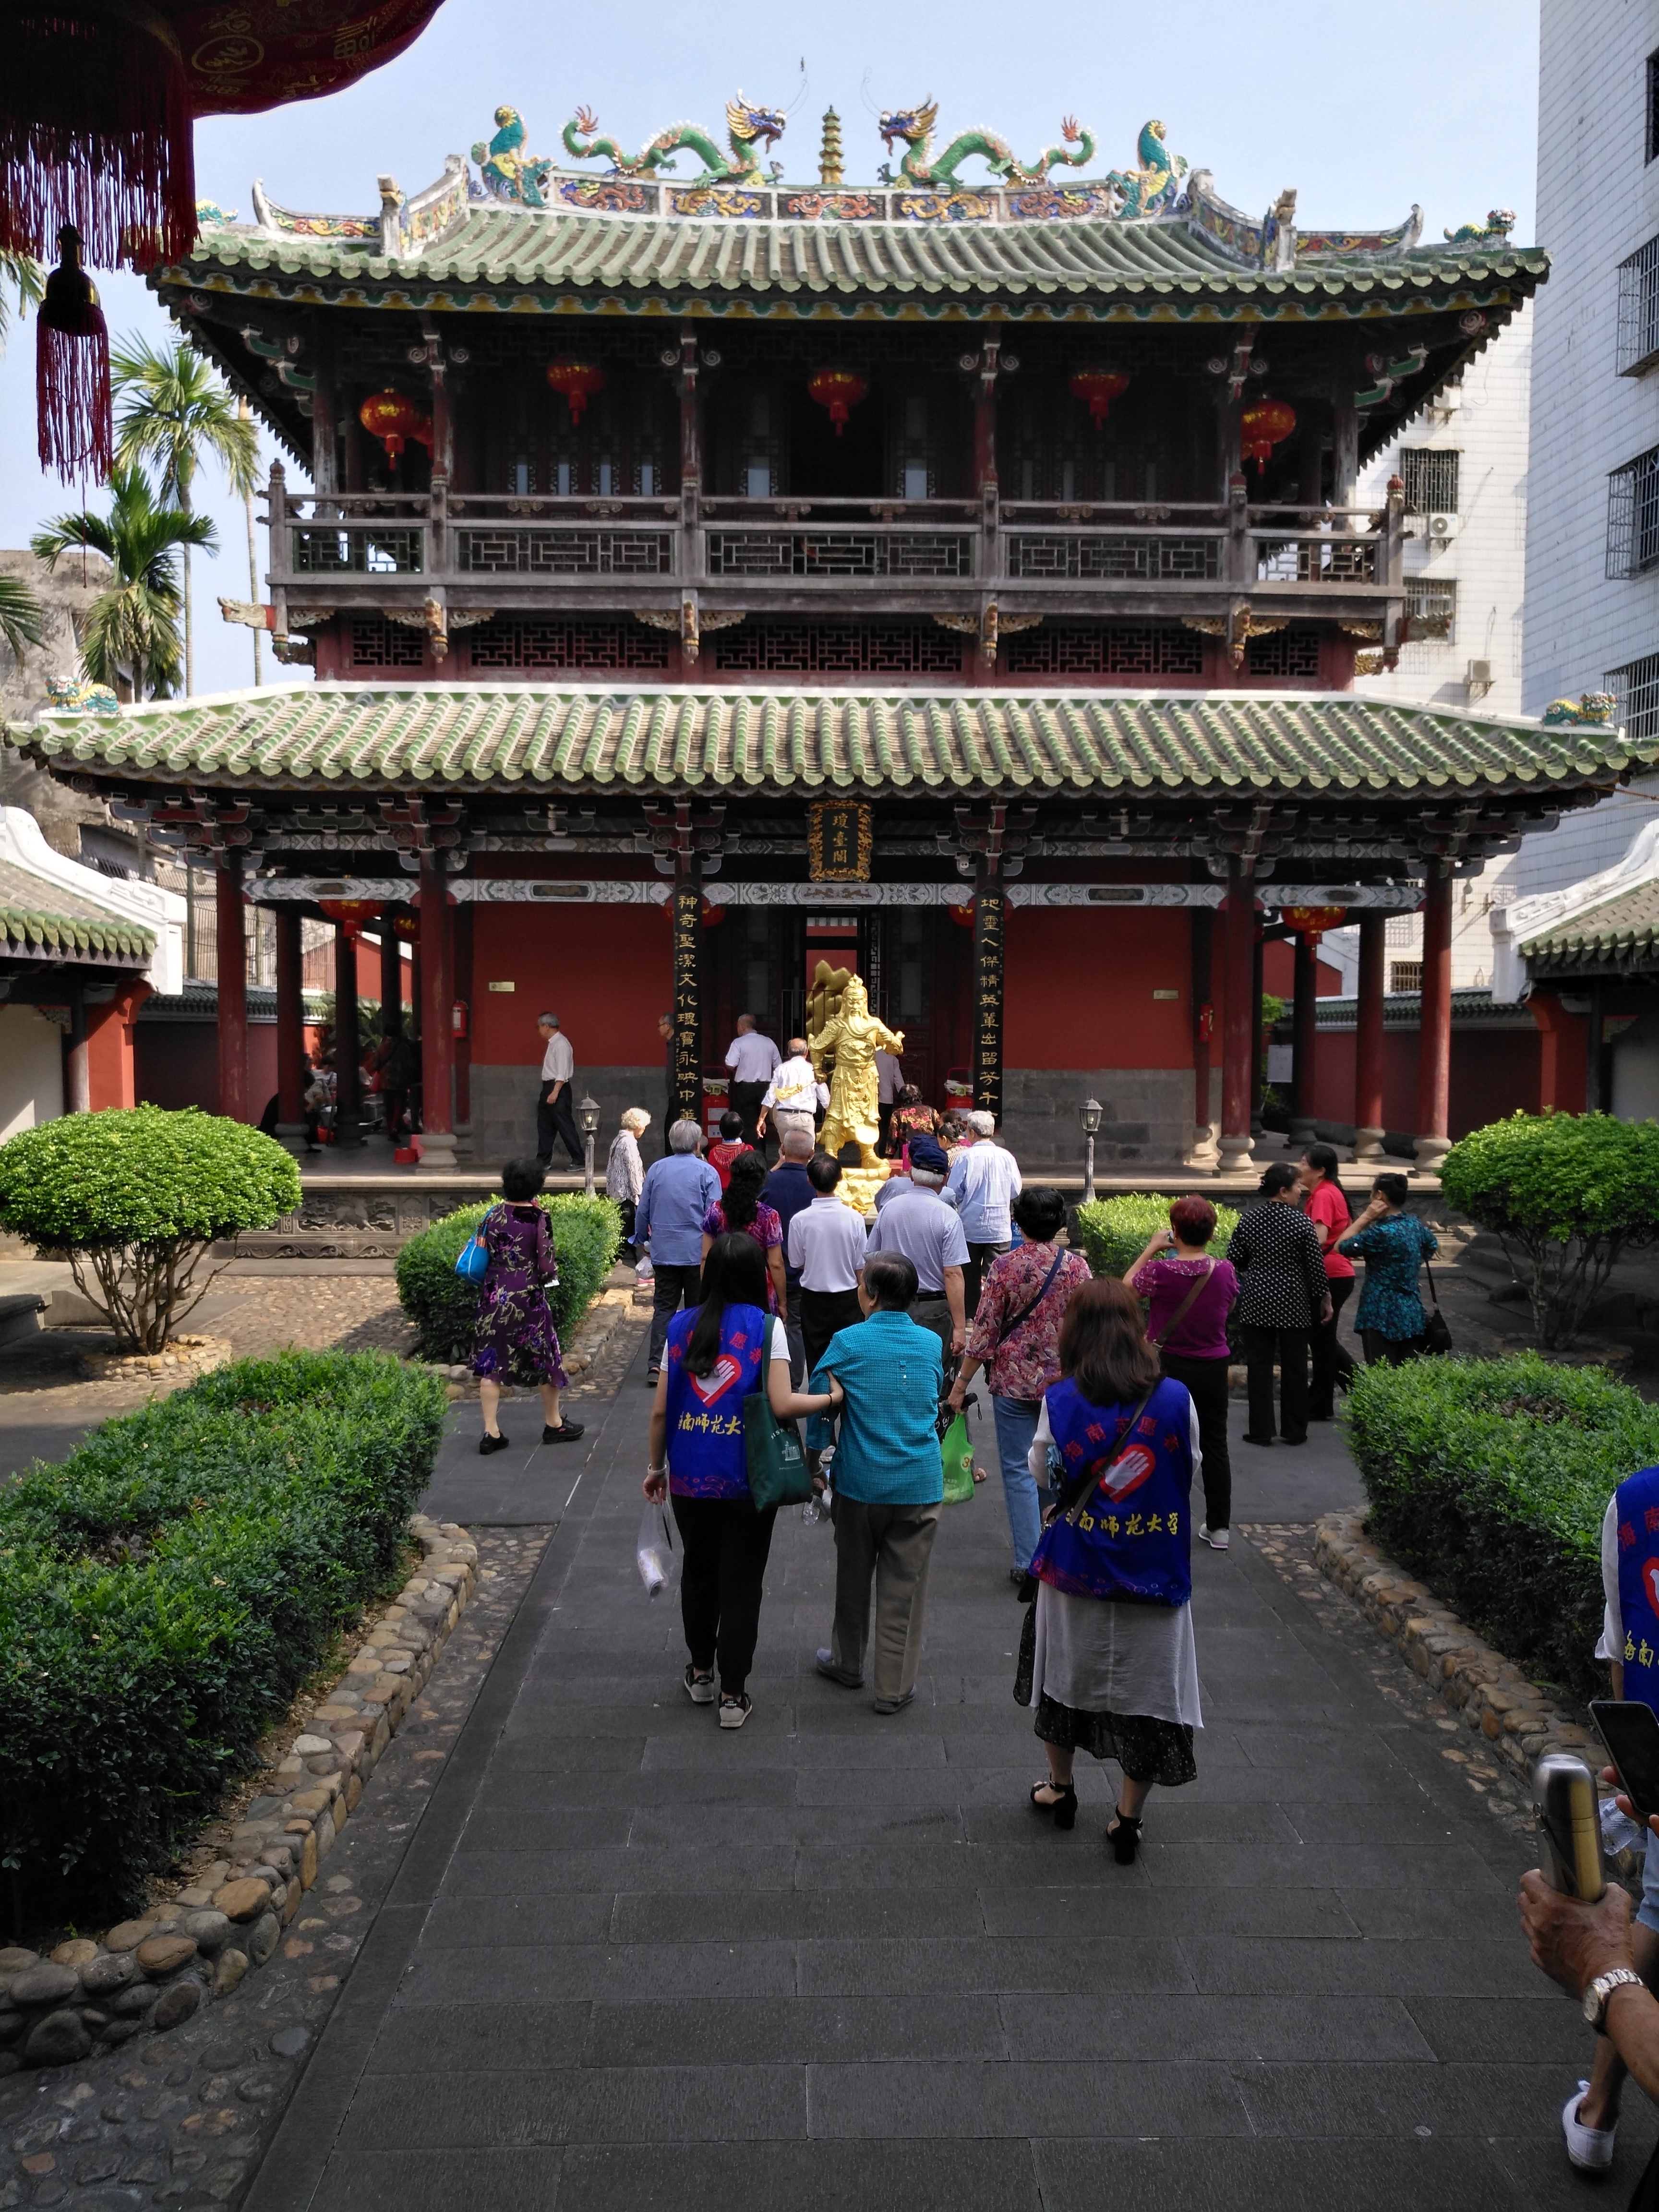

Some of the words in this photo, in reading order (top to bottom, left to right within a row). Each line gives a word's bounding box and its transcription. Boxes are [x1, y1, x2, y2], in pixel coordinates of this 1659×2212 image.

[978, 898, 1001, 1117] 地靈人傑精英輩出留芳千
